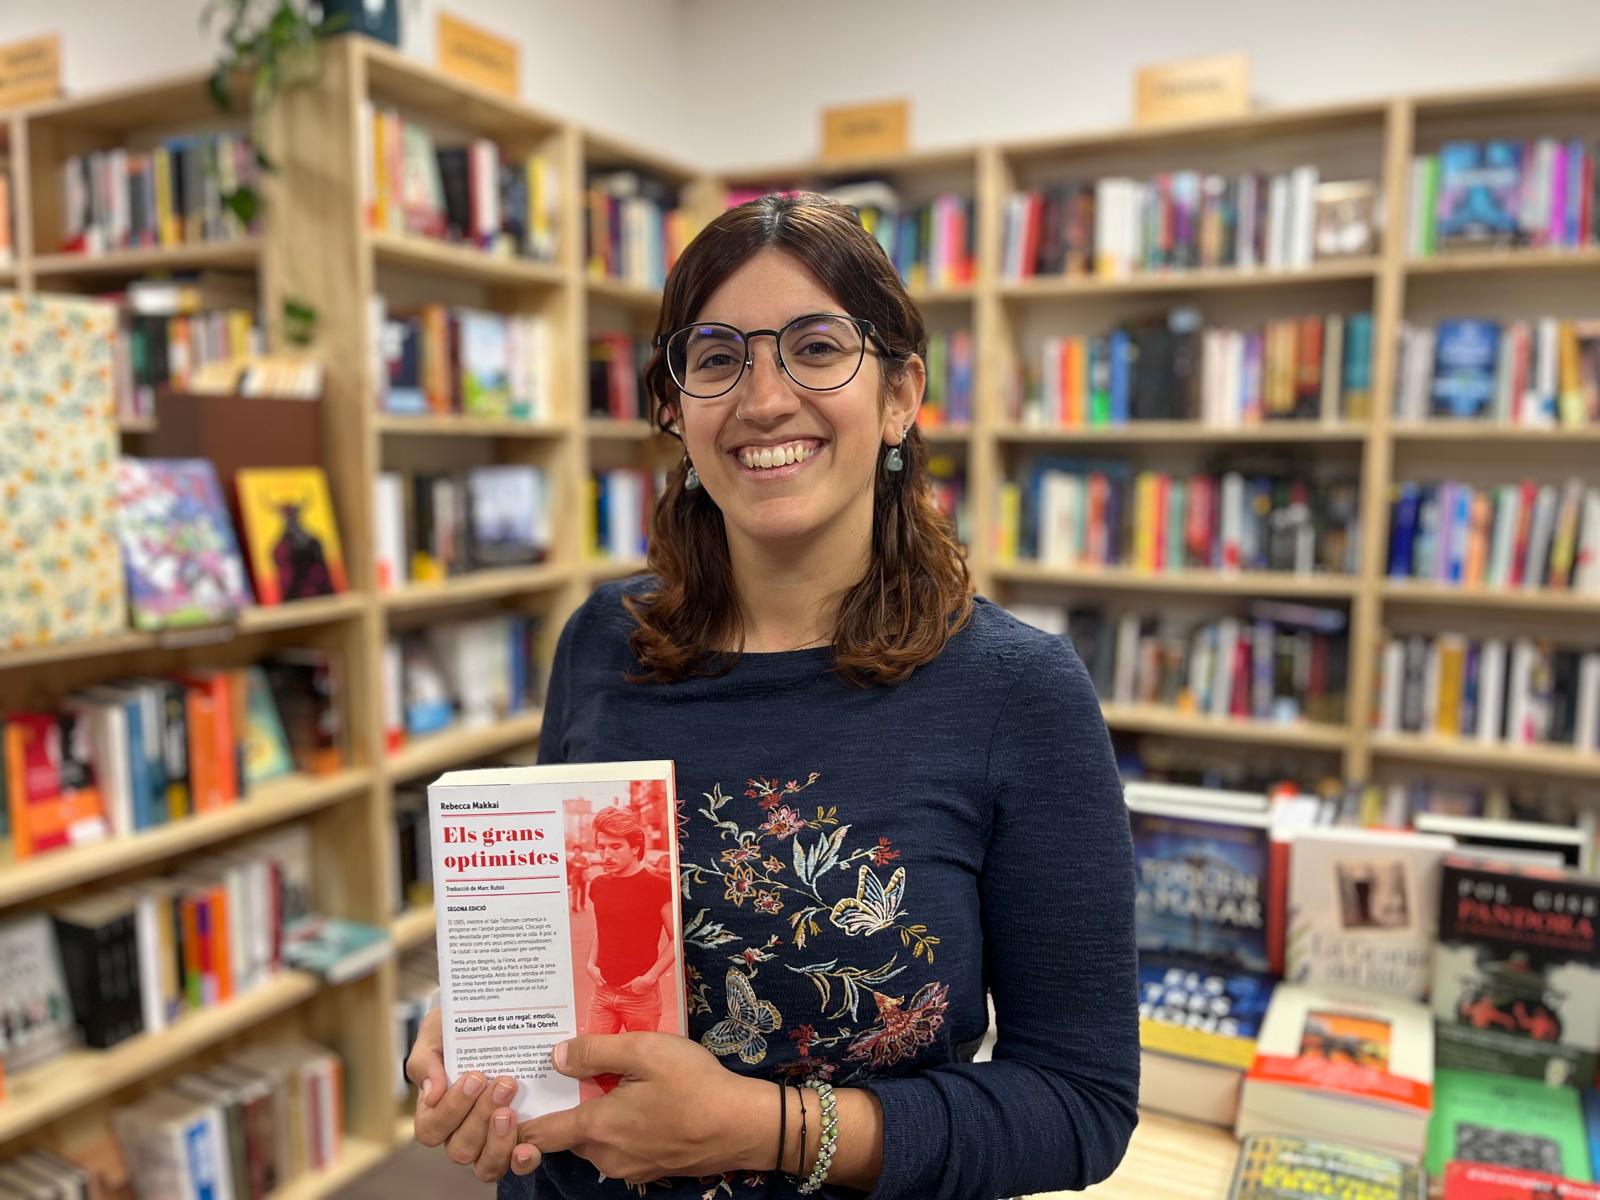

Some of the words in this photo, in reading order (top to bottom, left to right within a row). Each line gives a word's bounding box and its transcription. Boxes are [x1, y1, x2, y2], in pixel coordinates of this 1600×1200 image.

[444, 826, 477, 843] Els
[482, 828, 544, 847] grans
[444, 850, 559, 872] optimistes
[1457, 878, 1511, 904] POL
[1457, 898, 1594, 941] PANDORA
[532, 1012, 556, 1020] emotiu,
[486, 1023, 496, 1032] ple
